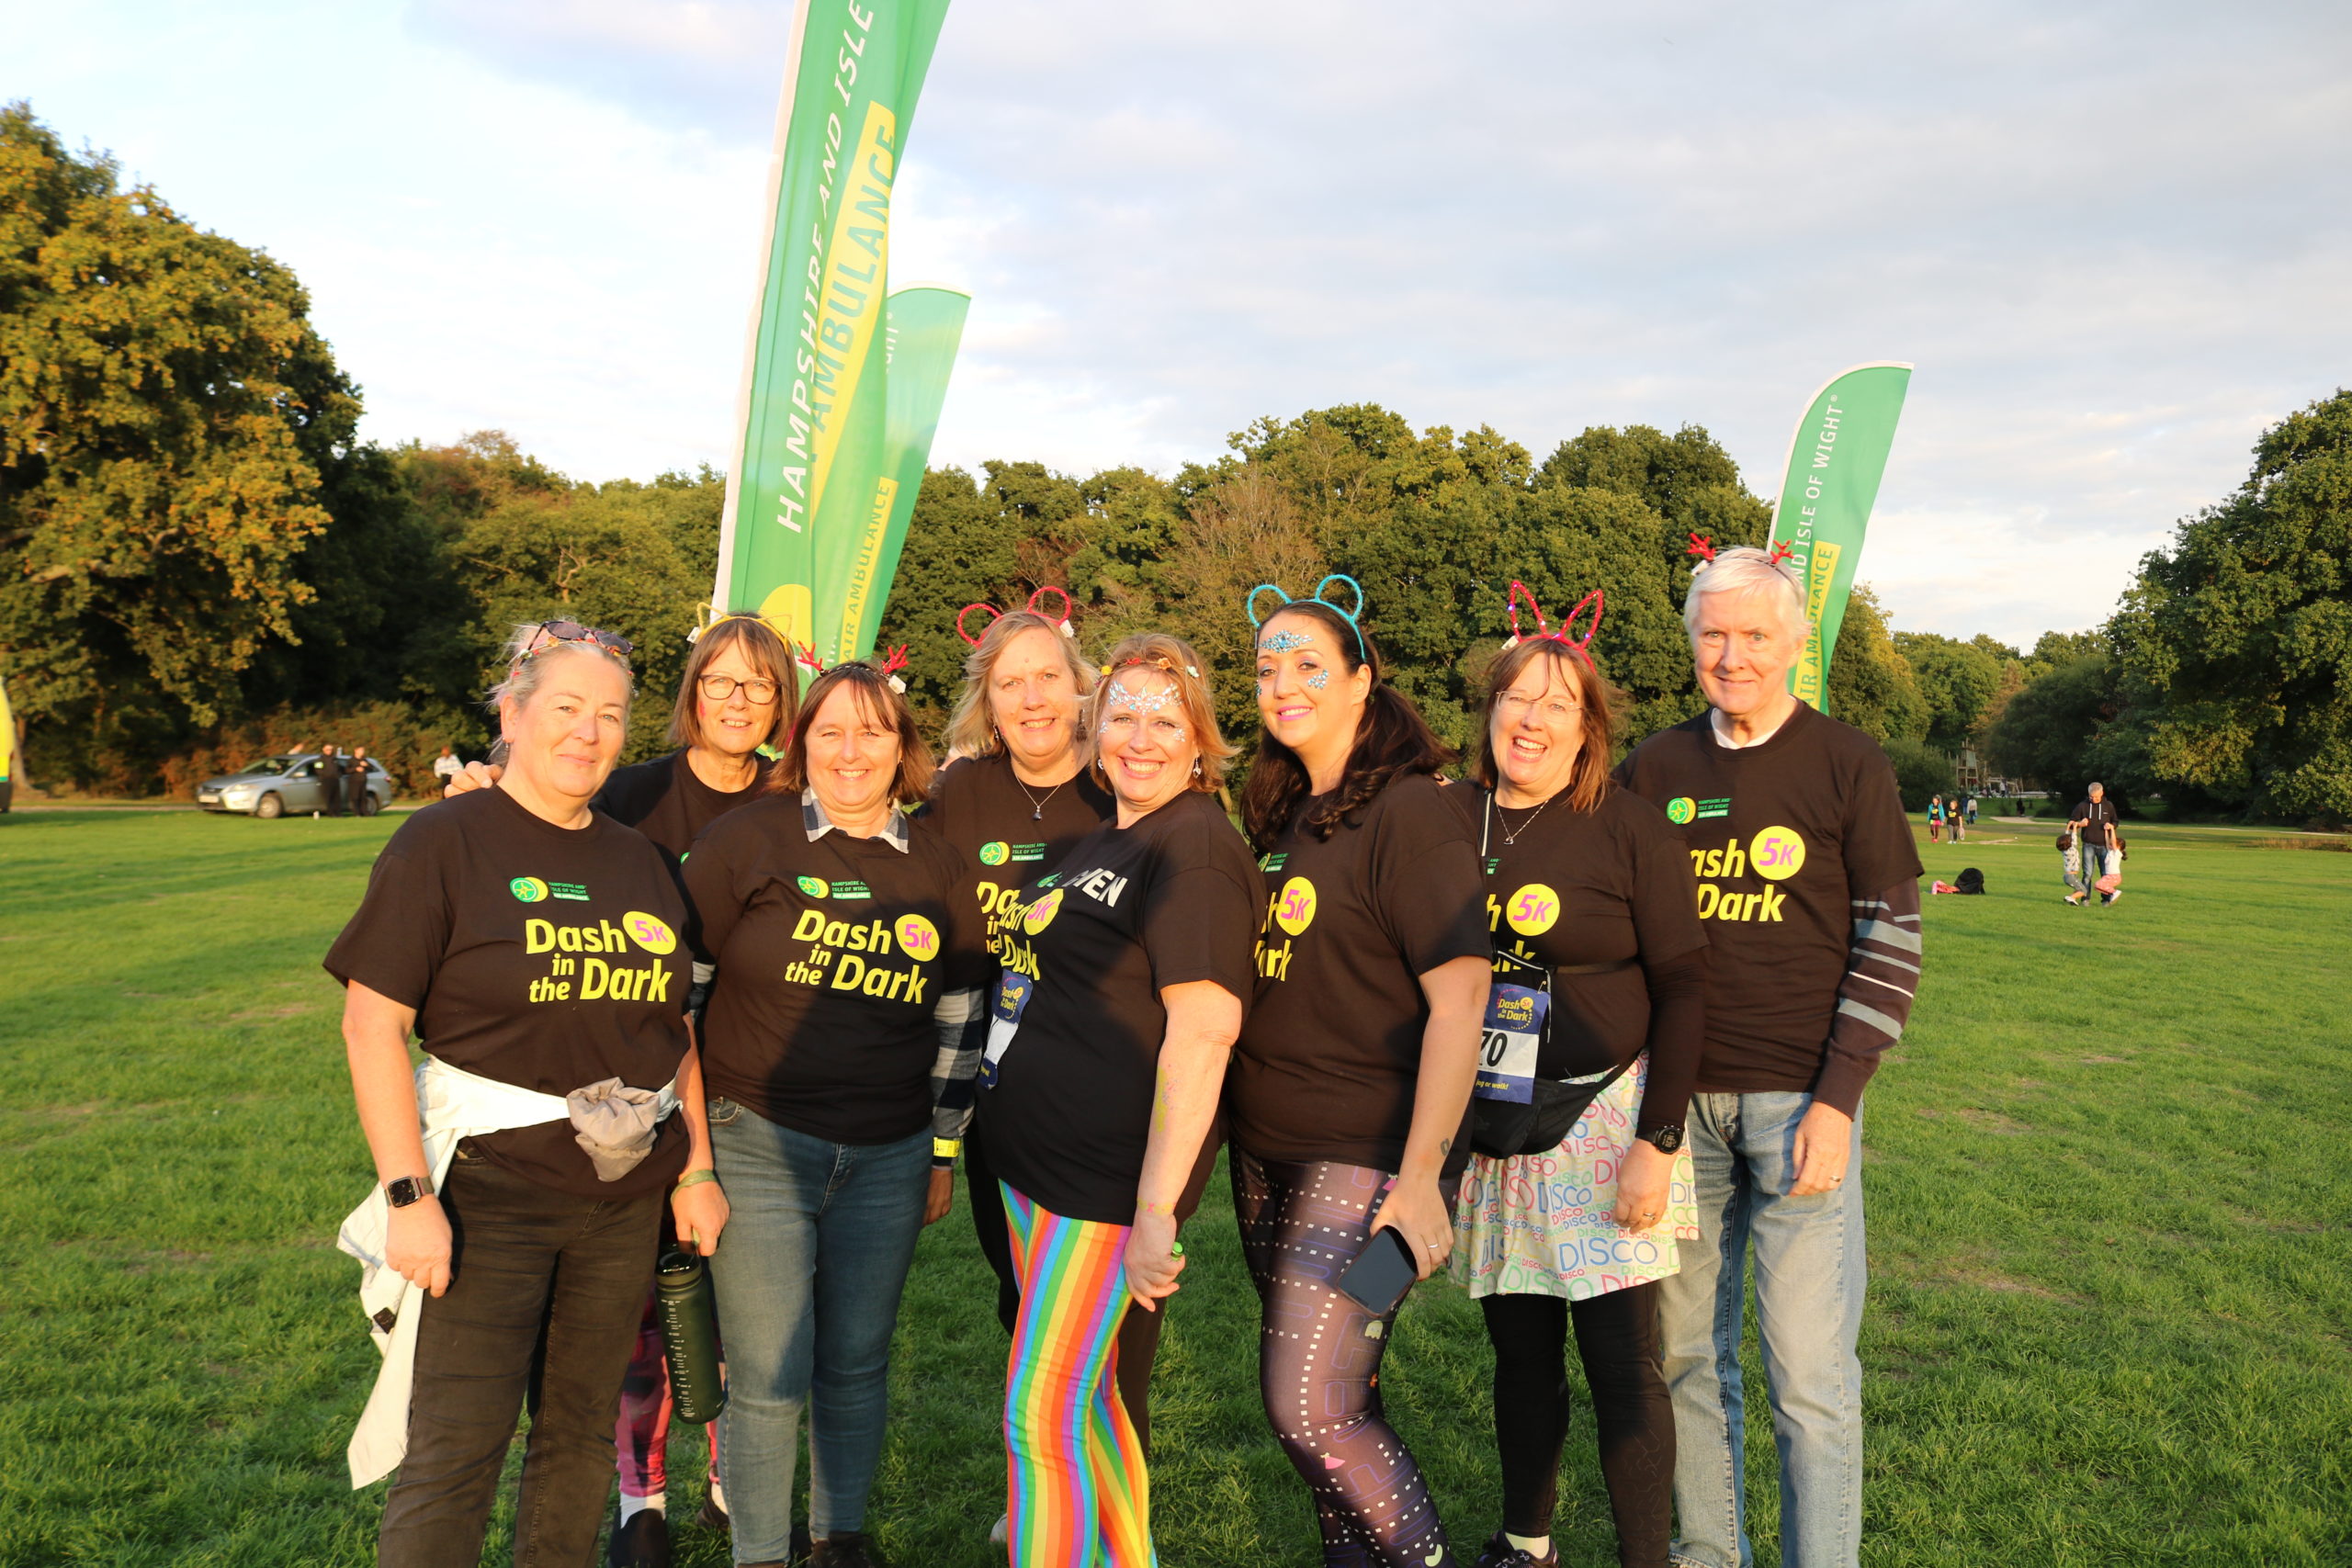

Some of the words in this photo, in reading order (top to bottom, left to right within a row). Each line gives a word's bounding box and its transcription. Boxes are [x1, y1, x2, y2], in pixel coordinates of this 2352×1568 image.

[776, 222, 823, 534] HAMPSHIRE
[820, 112, 842, 220] AND
[834, 0, 874, 107] ISLE
[1794, 505, 1816, 547] ISLE
[1805, 474, 1823, 500] OF
[849, 486, 890, 615] AMBULANCE
[843, 622, 856, 660] AIR
[1758, 838, 1797, 866] 5K
[1281, 888, 1311, 921] 5K
[1512, 894, 1554, 922] 5K
[1697, 883, 1786, 922] Dark
[526, 919, 627, 953] Dash
[634, 919, 669, 942] 5K
[791, 909, 892, 954] Dash
[903, 923, 933, 951] 5K
[552, 953, 574, 976] in
[808, 943, 831, 966] in
[529, 976, 571, 1003] the
[580, 957, 673, 1002] Dark
[784, 962, 822, 985] the
[831, 953, 927, 1004] Dark
[1498, 998, 1521, 1010] Dash
[1506, 1011, 1528, 1021] Dark
[1551, 1171, 1593, 1187] DISCO
[1538, 1182, 1592, 1213] DISCO
[1552, 1208, 1583, 1225] DISCO
[1564, 1213, 1598, 1230] DISCO
[1577, 1228, 1617, 1239] DISCO
[1558, 1237, 1657, 1272] DISCO
[1559, 1269, 1585, 1280] DISCO
[1621, 1265, 1667, 1277] DISCO
